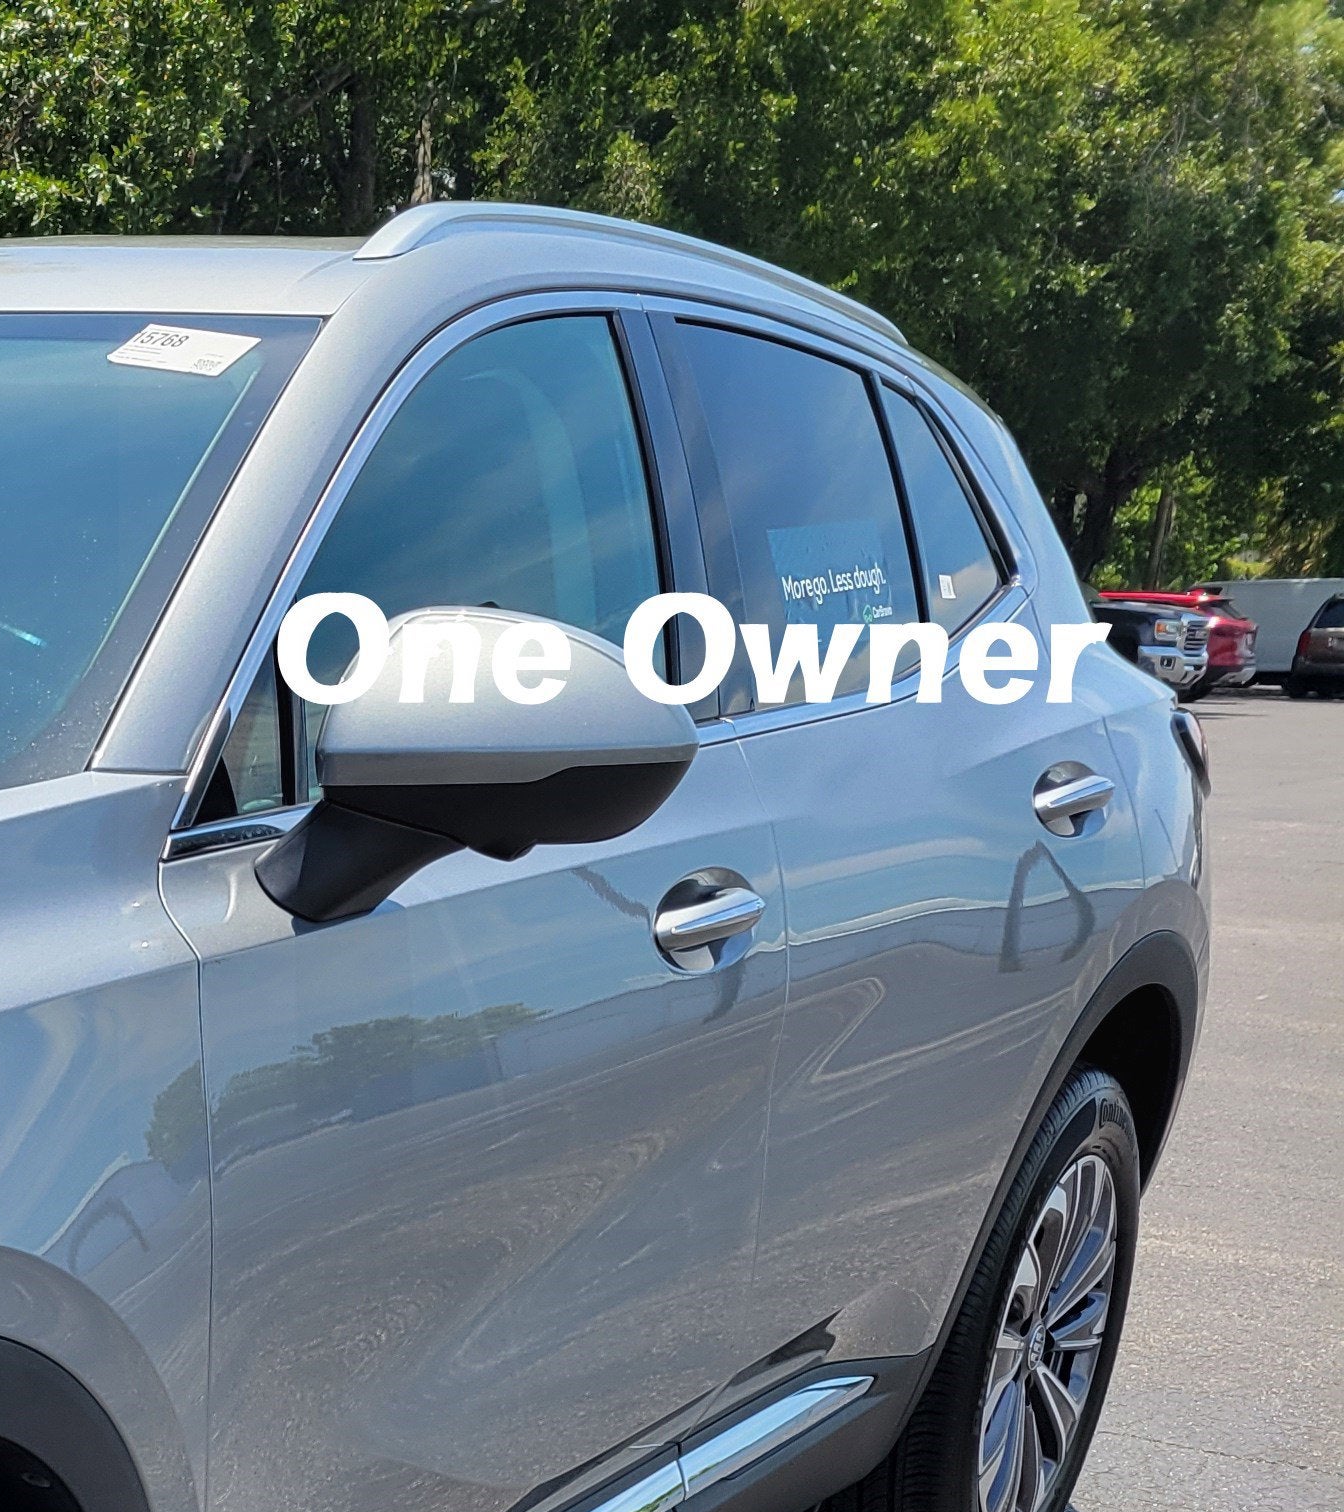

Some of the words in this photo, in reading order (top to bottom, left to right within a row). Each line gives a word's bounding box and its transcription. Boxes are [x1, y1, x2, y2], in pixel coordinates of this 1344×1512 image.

[781, 574, 814, 601] More
[828, 568, 854, 593] Less
[853, 561, 887, 595] dough.
